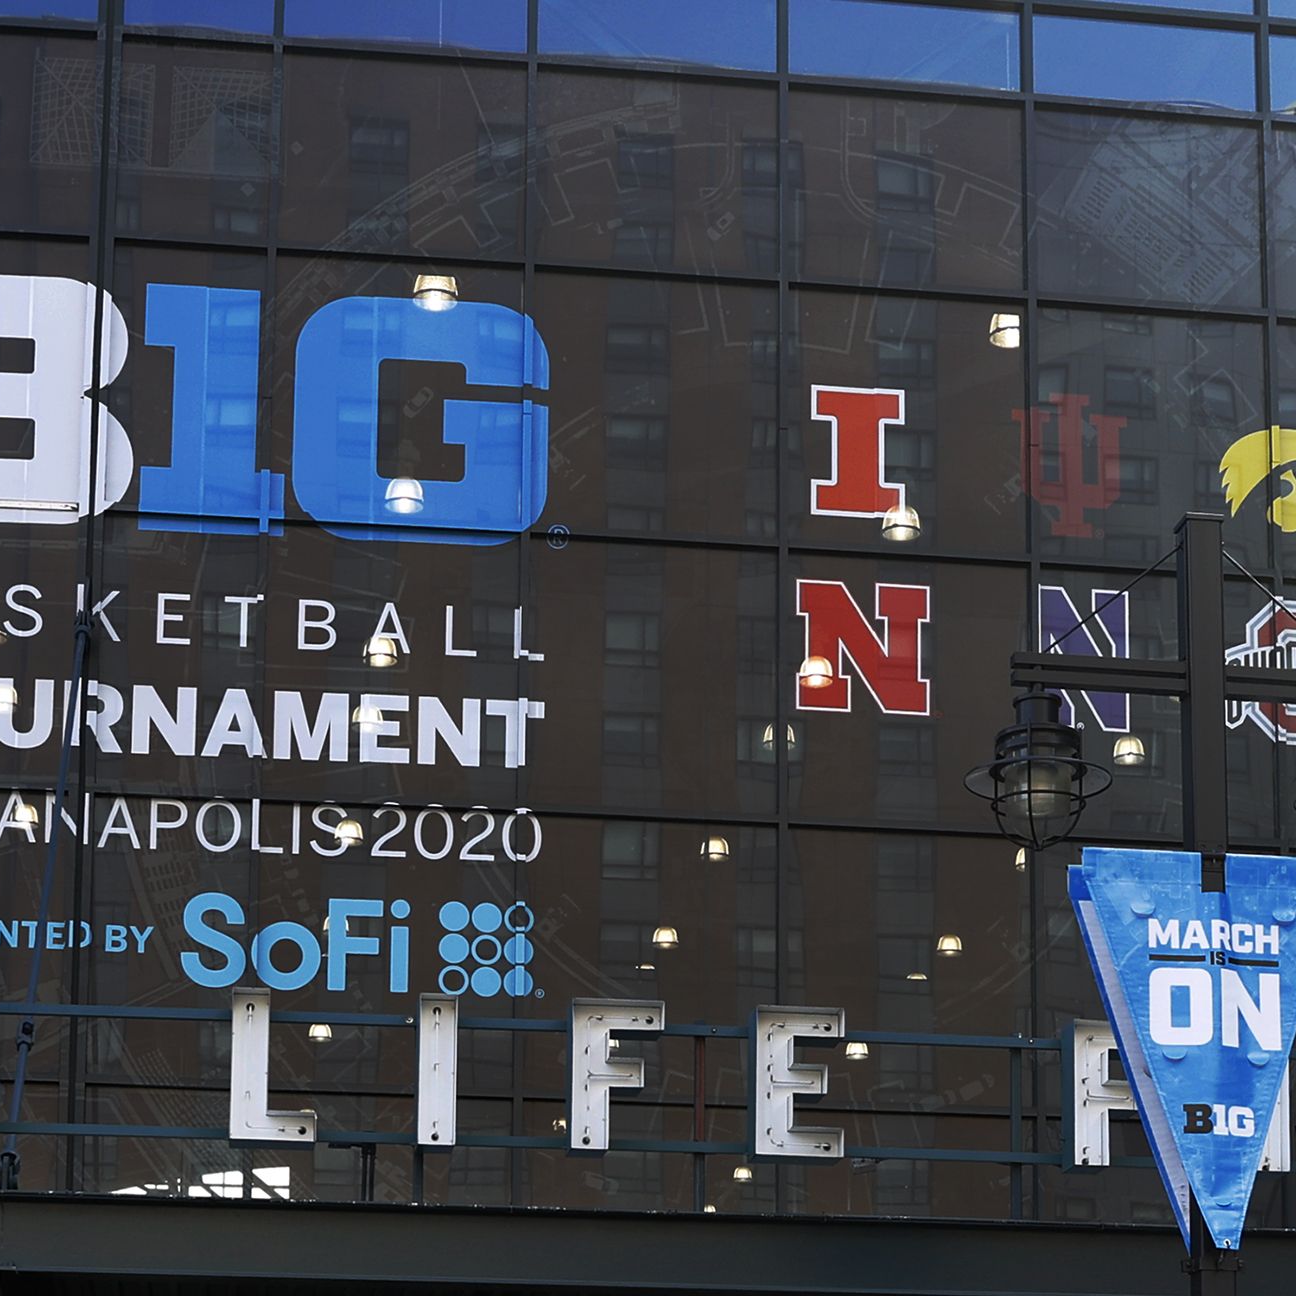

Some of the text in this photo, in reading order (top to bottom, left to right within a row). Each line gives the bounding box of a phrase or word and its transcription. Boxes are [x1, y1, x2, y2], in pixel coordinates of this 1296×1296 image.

[796, 579, 931, 716] N
[371, 804, 542, 864] 2020
[105, 924, 154, 954] BY
[180, 891, 411, 994] SoFi
[1148, 919, 1279, 955] MARCH
[1210, 951, 1225, 966] IS
[1149, 967, 1282, 1051] ON
[229, 986, 846, 1160] LIFE
